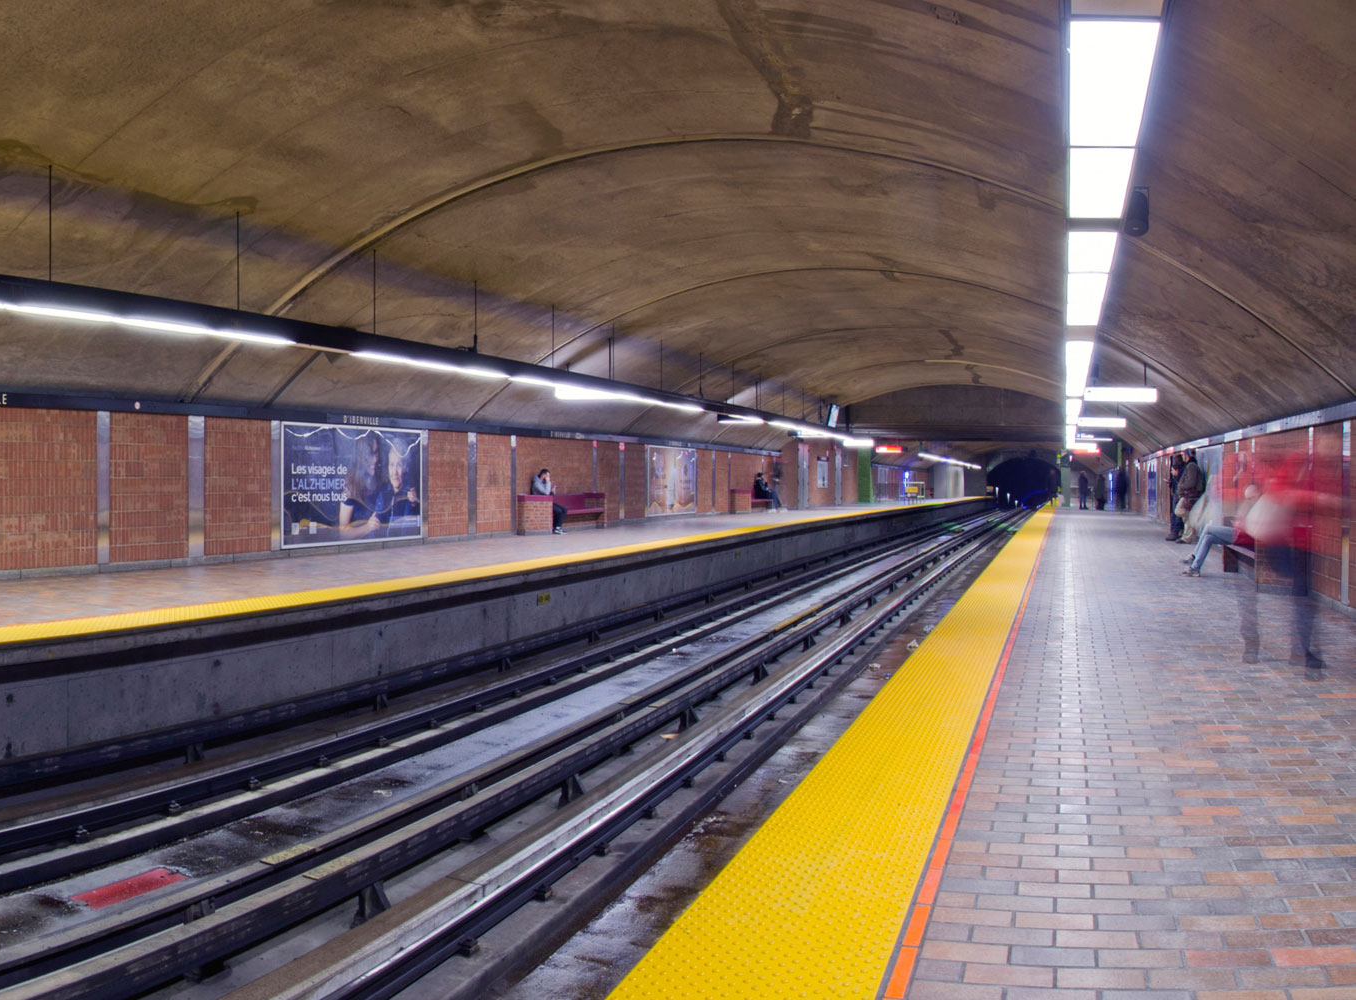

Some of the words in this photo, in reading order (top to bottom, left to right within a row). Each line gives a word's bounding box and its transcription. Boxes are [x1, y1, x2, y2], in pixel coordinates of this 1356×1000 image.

[343, 414, 379, 425] D'IBERVILLE
[291, 463, 307, 475] Les
[307, 463, 336, 477] visages
[337, 463, 348, 475] de
[291, 491, 311, 502] c'est
[312, 493, 331, 502] nous
[331, 491, 347, 502] tous
